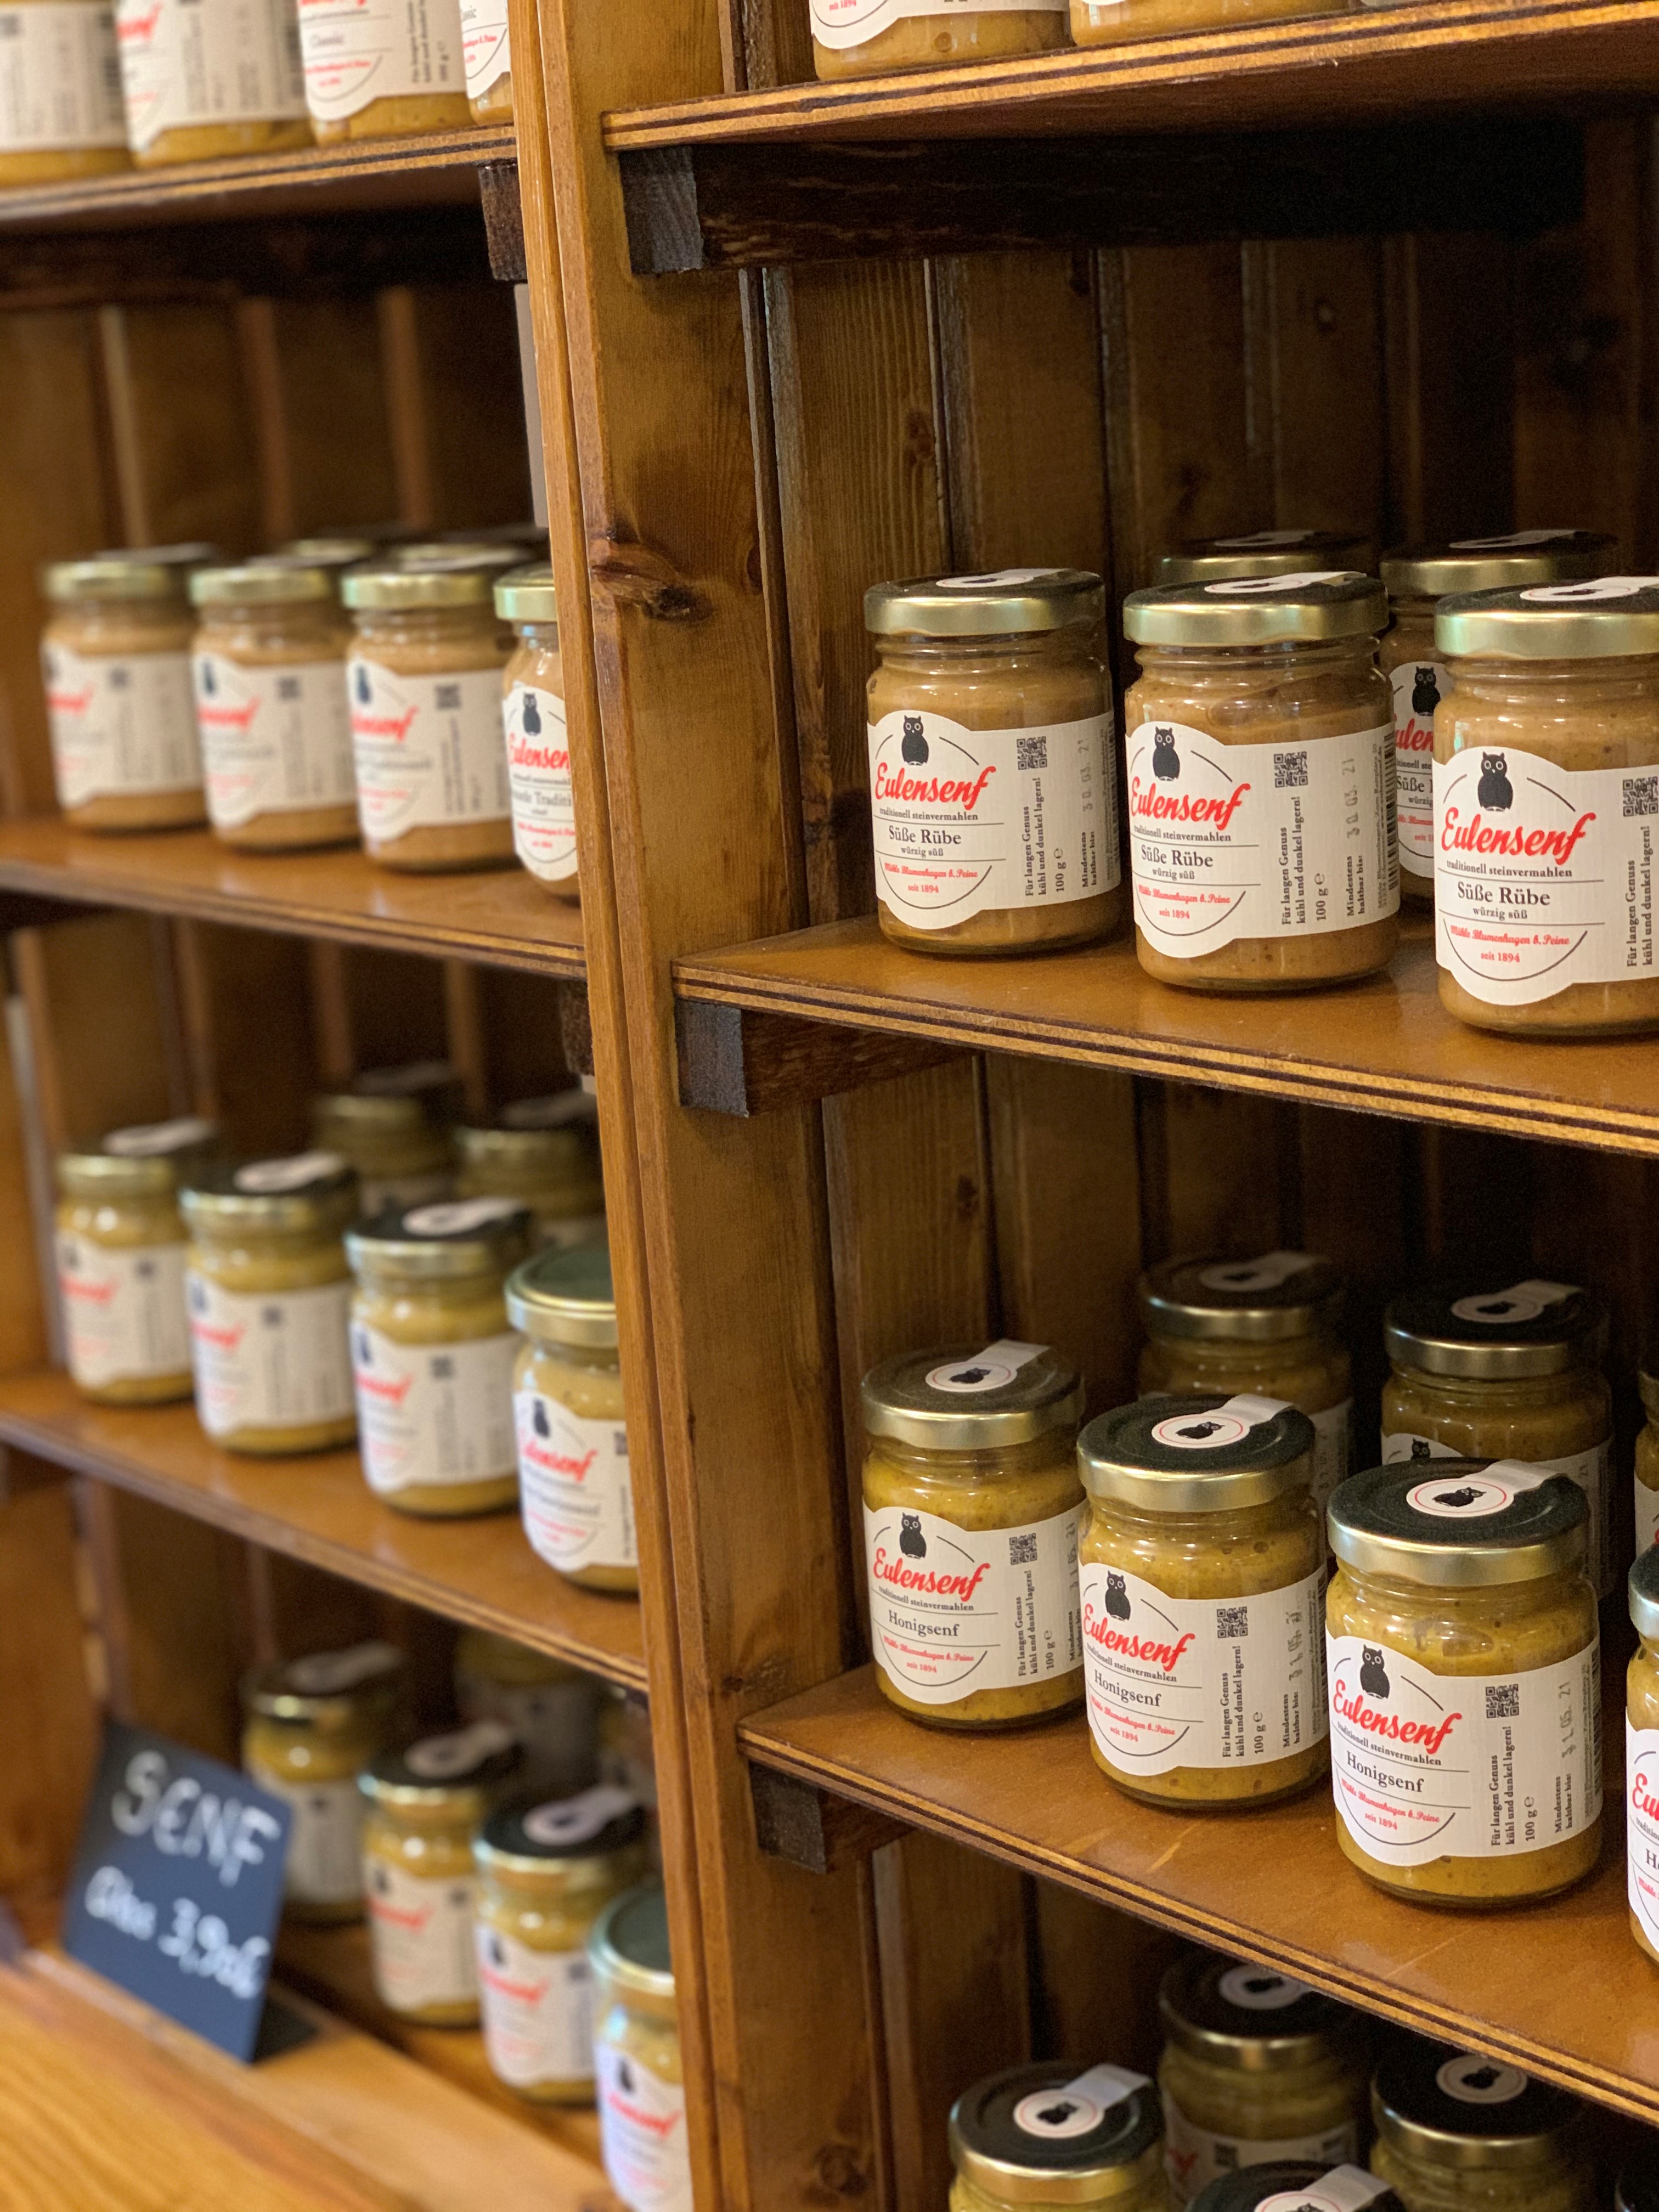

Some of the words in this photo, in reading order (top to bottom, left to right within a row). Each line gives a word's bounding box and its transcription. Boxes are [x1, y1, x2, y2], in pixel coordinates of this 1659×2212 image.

[875, 762, 996, 810] Eulensenf
[1032, 777, 1044, 812] lagern!
[1131, 776, 1251, 831] Eulensenf
[1291, 796, 1304, 834] lagern!
[913, 811, 978, 821] steinvermahlen
[1022, 806, 1030, 842] Genuss
[889, 825, 916, 843] Süße
[921, 829, 962, 844] Rübe
[1034, 814, 1045, 848] dunkel
[1163, 831, 1231, 842] steinvermahlen
[1441, 806, 1596, 865] Eulensenf
[901, 847, 926, 857] würzig
[929, 848, 944, 856] süß
[1141, 844, 1167, 864] Süße
[1171, 850, 1214, 867] Rübe
[1279, 827, 1288, 866] Genuss
[1293, 836, 1303, 873] dunkel
[1640, 825, 1654, 866] lagern!
[1024, 844, 1034, 877] langen
[1447, 860, 1487, 874] traditionell
[1489, 866, 1572, 877] steinvermahlen
[1038, 872, 1046, 895] kühl
[1055, 873, 1064, 893] 100
[1152, 868, 1177, 881] würzig
[1180, 871, 1195, 879] süß
[1295, 876, 1304, 896] und
[1346, 856, 1355, 917] Mindestens
[1625, 860, 1636, 902] Genuss
[921, 885, 939, 893] 1894
[1025, 883, 1034, 896] Für
[1280, 868, 1293, 909] langen
[1318, 888, 1328, 896] g
[1458, 881, 1493, 902] Süße
[1499, 887, 1550, 905] Rübe
[1641, 869, 1651, 910] dunkel
[1172, 910, 1190, 919] 1894
[1282, 911, 1291, 925] Für
[1296, 899, 1305, 923] kühl
[1316, 900, 1326, 921] 100
[1473, 907, 1505, 921] würzig
[1508, 910, 1527, 919] süß
[1626, 905, 1639, 944] langen
[1641, 913, 1652, 936] und
[1543, 934, 1570, 945] Peine
[1498, 952, 1520, 963] 1894
[1627, 947, 1637, 967] Für
[1642, 938, 1652, 966] kühl
[873, 1547, 990, 1602] Eulensenf
[1024, 1570, 1035, 1601] lagern!
[911, 1599, 974, 1611] steinvermahlen
[1015, 1596, 1023, 1628] Genuss
[1026, 1602, 1035, 1632] dunkel
[889, 1609, 960, 1637] Honigsenf
[1017, 1630, 1026, 1659] langen
[1084, 1603, 1195, 1672] Eulensenf
[919, 1663, 937, 1673] 1894
[1045, 1652, 1054, 1670] 100
[1114, 1662, 1177, 1682] steinvermahlen
[1232, 1645, 1244, 1678] lagern!
[1094, 1669, 1161, 1707] Honigsenf
[1220, 1673, 1229, 1706] Genuss
[1233, 1680, 1243, 1713] dunkel
[1222, 1708, 1233, 1740] langen
[1235, 1714, 1243, 1733] und
[1333, 1679, 1462, 1754] Eulensenf
[1122, 1730, 1138, 1742] 1894
[1235, 1735, 1244, 1757] kühl
[1254, 1735, 1263, 1754] 100
[1502, 1726, 1515, 1760] lagern!
[1222, 1743, 1231, 1758] Für
[1370, 1742, 1441, 1766] steinvermahlen
[1347, 1751, 1424, 1792] Honigsenf
[1489, 1755, 1499, 1791] Genuss
[1503, 1763, 1514, 1797] dunkel
[112, 1750, 281, 1888] SENF
[1491, 1793, 1502, 1827] langen
[1504, 1799, 1514, 1819] und
[1379, 1816, 1397, 1830] 1894
[1506, 1822, 1515, 1845] kühl
[1525, 1821, 1535, 1841] 100
[1492, 1831, 1500, 1847] Für
